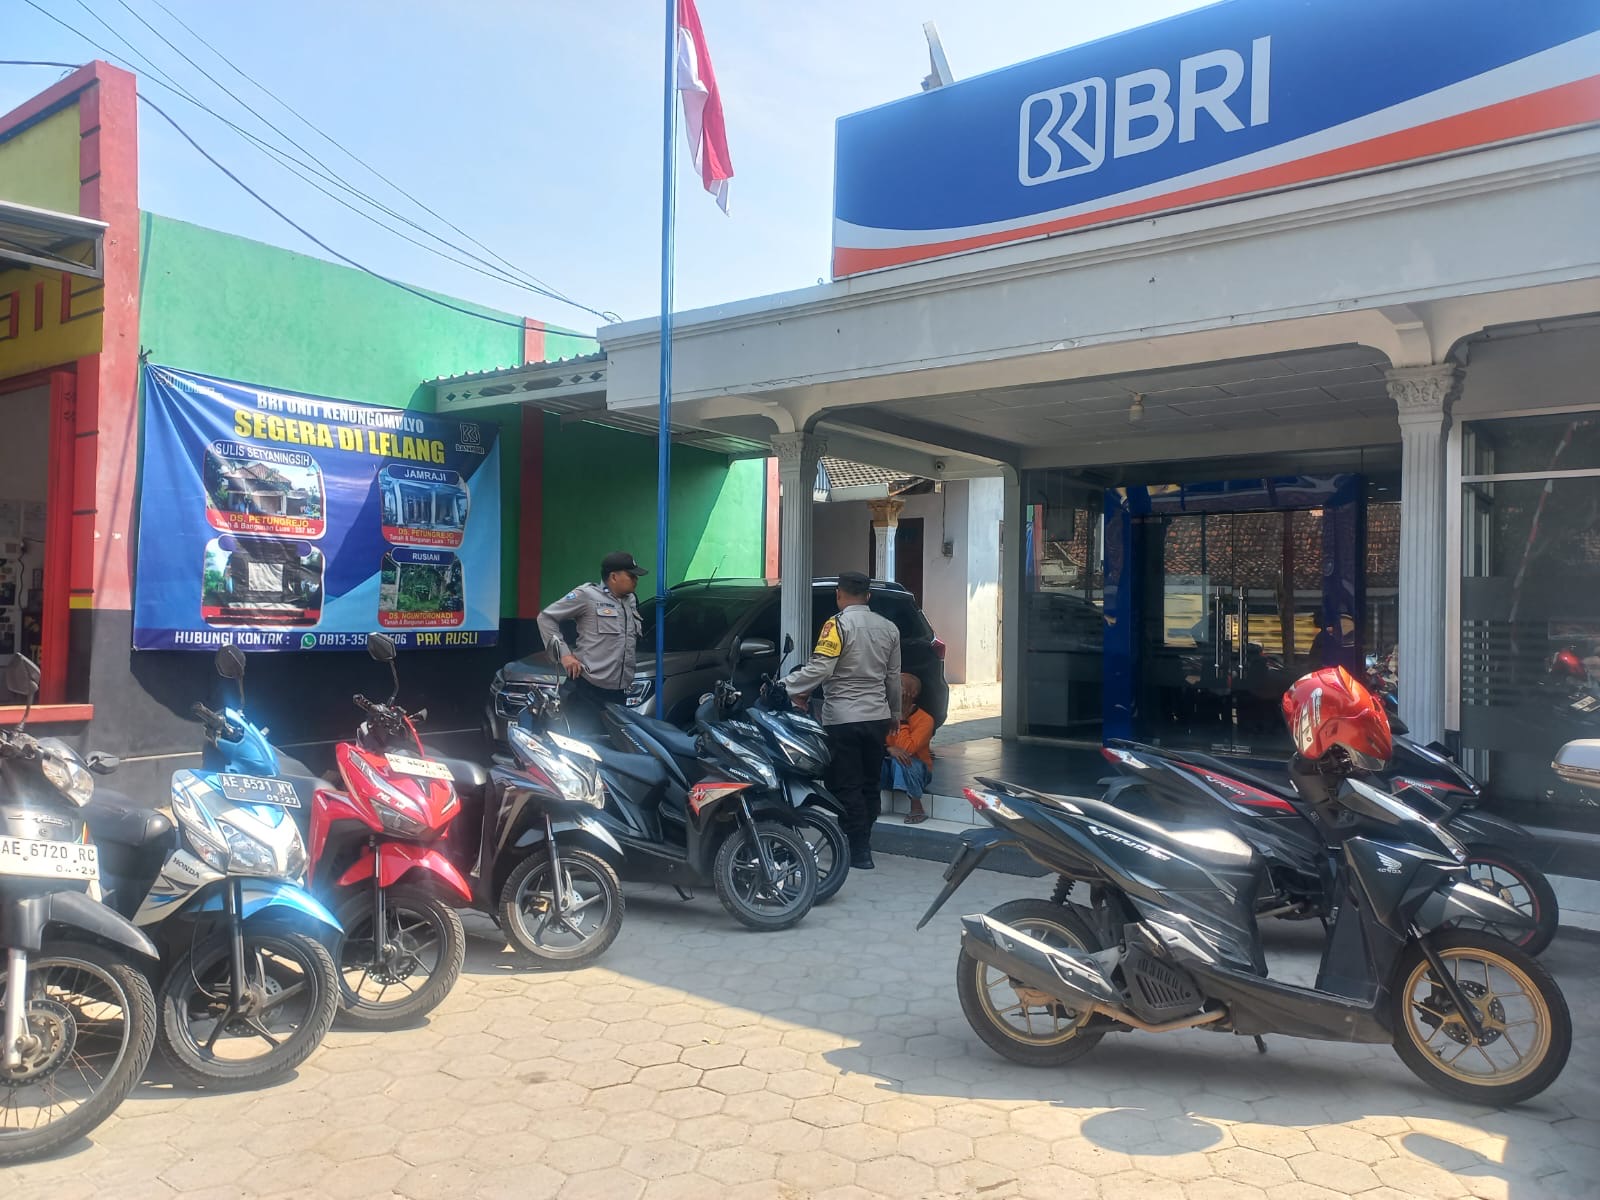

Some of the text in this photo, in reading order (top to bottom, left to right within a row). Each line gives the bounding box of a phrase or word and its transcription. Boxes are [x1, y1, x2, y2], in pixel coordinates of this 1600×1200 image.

[1113, 35, 1272, 159] BRI
[257, 393, 284, 412] BRI
[234, 409, 445, 465] SEGERA DI LELANG
[215, 443, 310, 466] SULIS SETYANINGSIH
[404, 469, 446, 481] JAMRAJI
[175, 631, 233, 645] HUBUNGI
[237, 631, 283, 645] KONTAK
[416, 631, 478, 646] PAK RUSLI
[222, 775, 239, 787] AE
[1, 840, 96, 862] AE 6720 RC
[172, 856, 200, 879] HONDA
